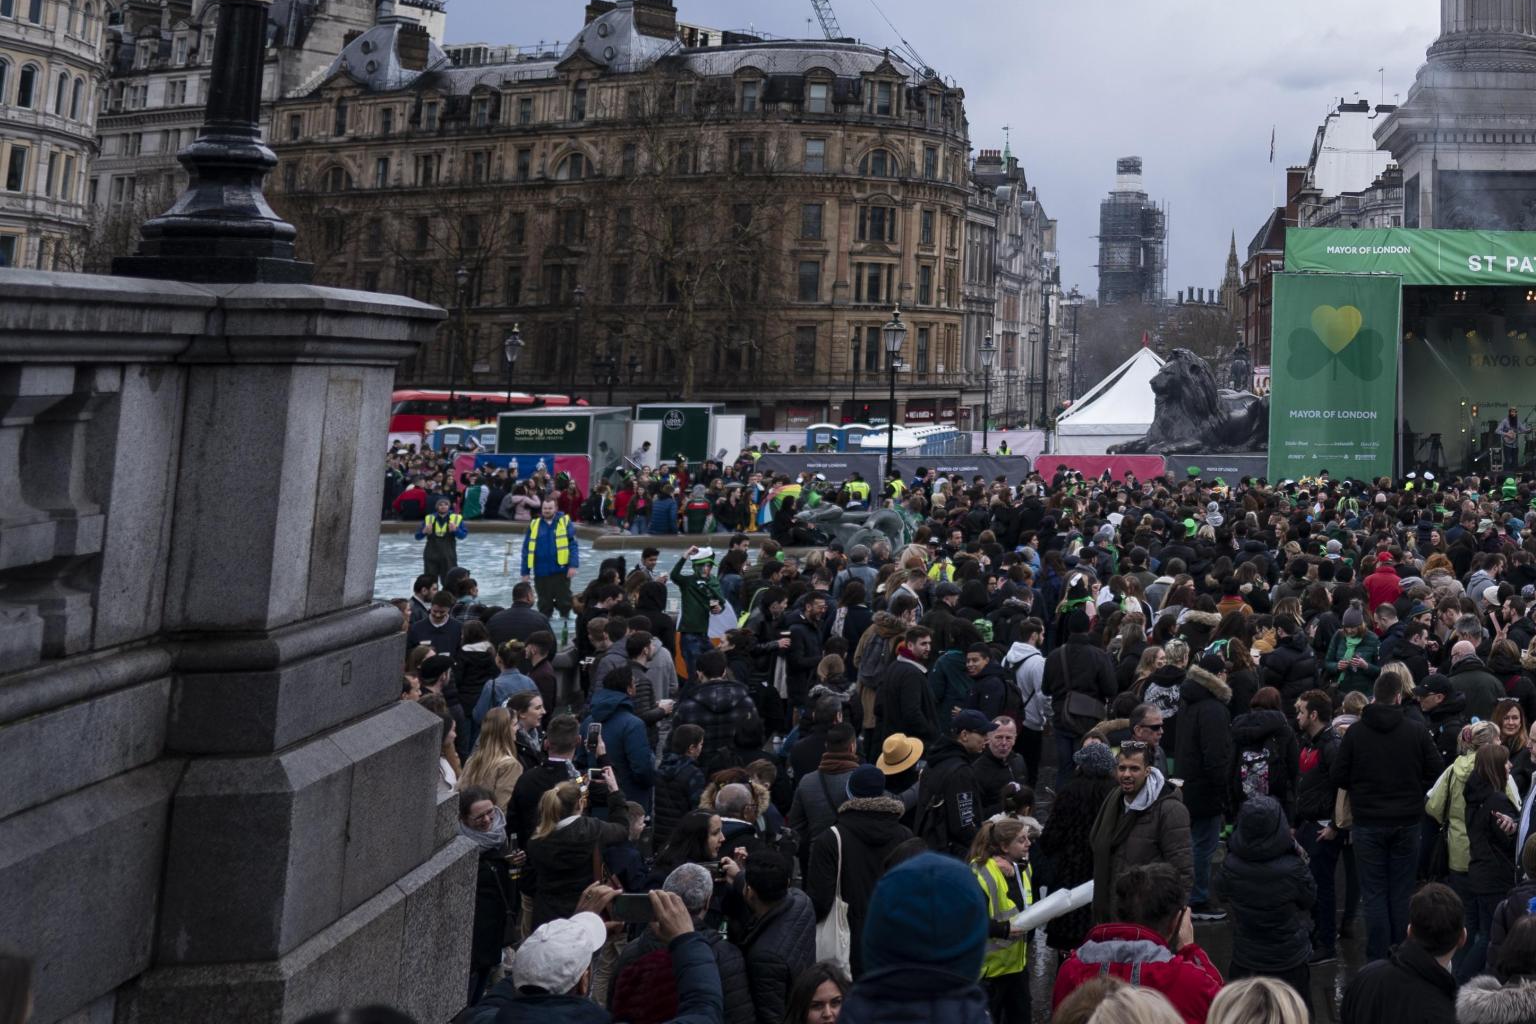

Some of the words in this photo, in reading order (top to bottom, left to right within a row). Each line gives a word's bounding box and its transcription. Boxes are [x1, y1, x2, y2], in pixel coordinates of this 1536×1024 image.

[1326, 246, 1358, 255] MAYOR
[1359, 246, 1372, 255] OF
[1373, 245, 1411, 254] LONDON
[1468, 255, 1497, 272] ST
[1467, 354, 1521, 367] MAYOR
[1289, 410, 1321, 418] MAYOR
[1322, 410, 1336, 418] OF
[1337, 411, 1377, 419] LONDON
[514, 428, 544, 437] Simply
[544, 428, 564, 436] loos
